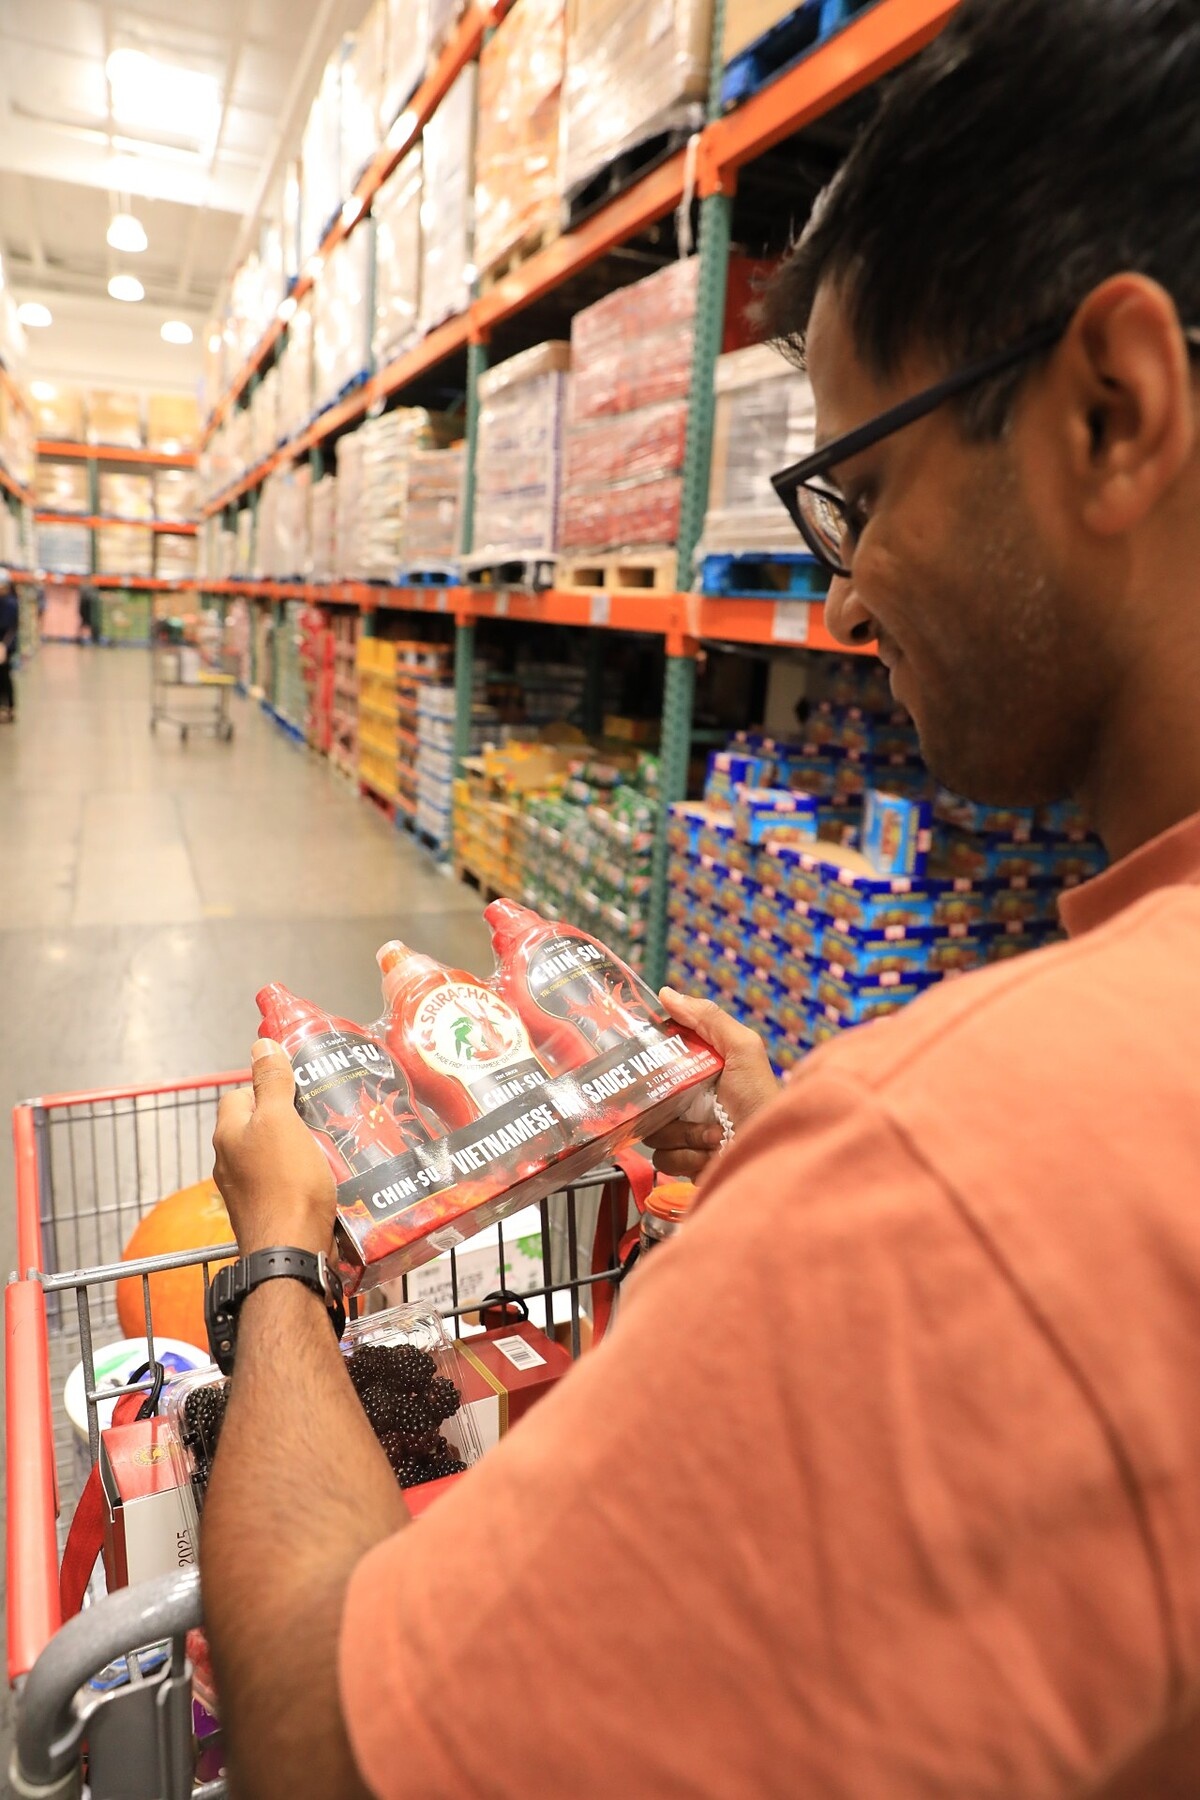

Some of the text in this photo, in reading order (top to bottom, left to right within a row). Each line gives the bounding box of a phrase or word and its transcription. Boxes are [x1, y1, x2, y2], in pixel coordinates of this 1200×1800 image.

[530, 944, 601, 985] CHIN-SU
[420, 986, 489, 1025] SRIRACHA
[327, 1036, 347, 1047] Sauce
[293, 1043, 382, 1087] CHIN-SU
[310, 1080, 338, 1098] ORIGINAL
[482, 1070, 547, 1109] CHIN-SU
[371, 1164, 441, 1209] CHIN-SU
[449, 1103, 560, 1176] VIETNAMESE
[581, 1063, 637, 1104] SAUCE
[627, 1033, 690, 1077] VARIETY
[176, 1529, 194, 1568] 2025
